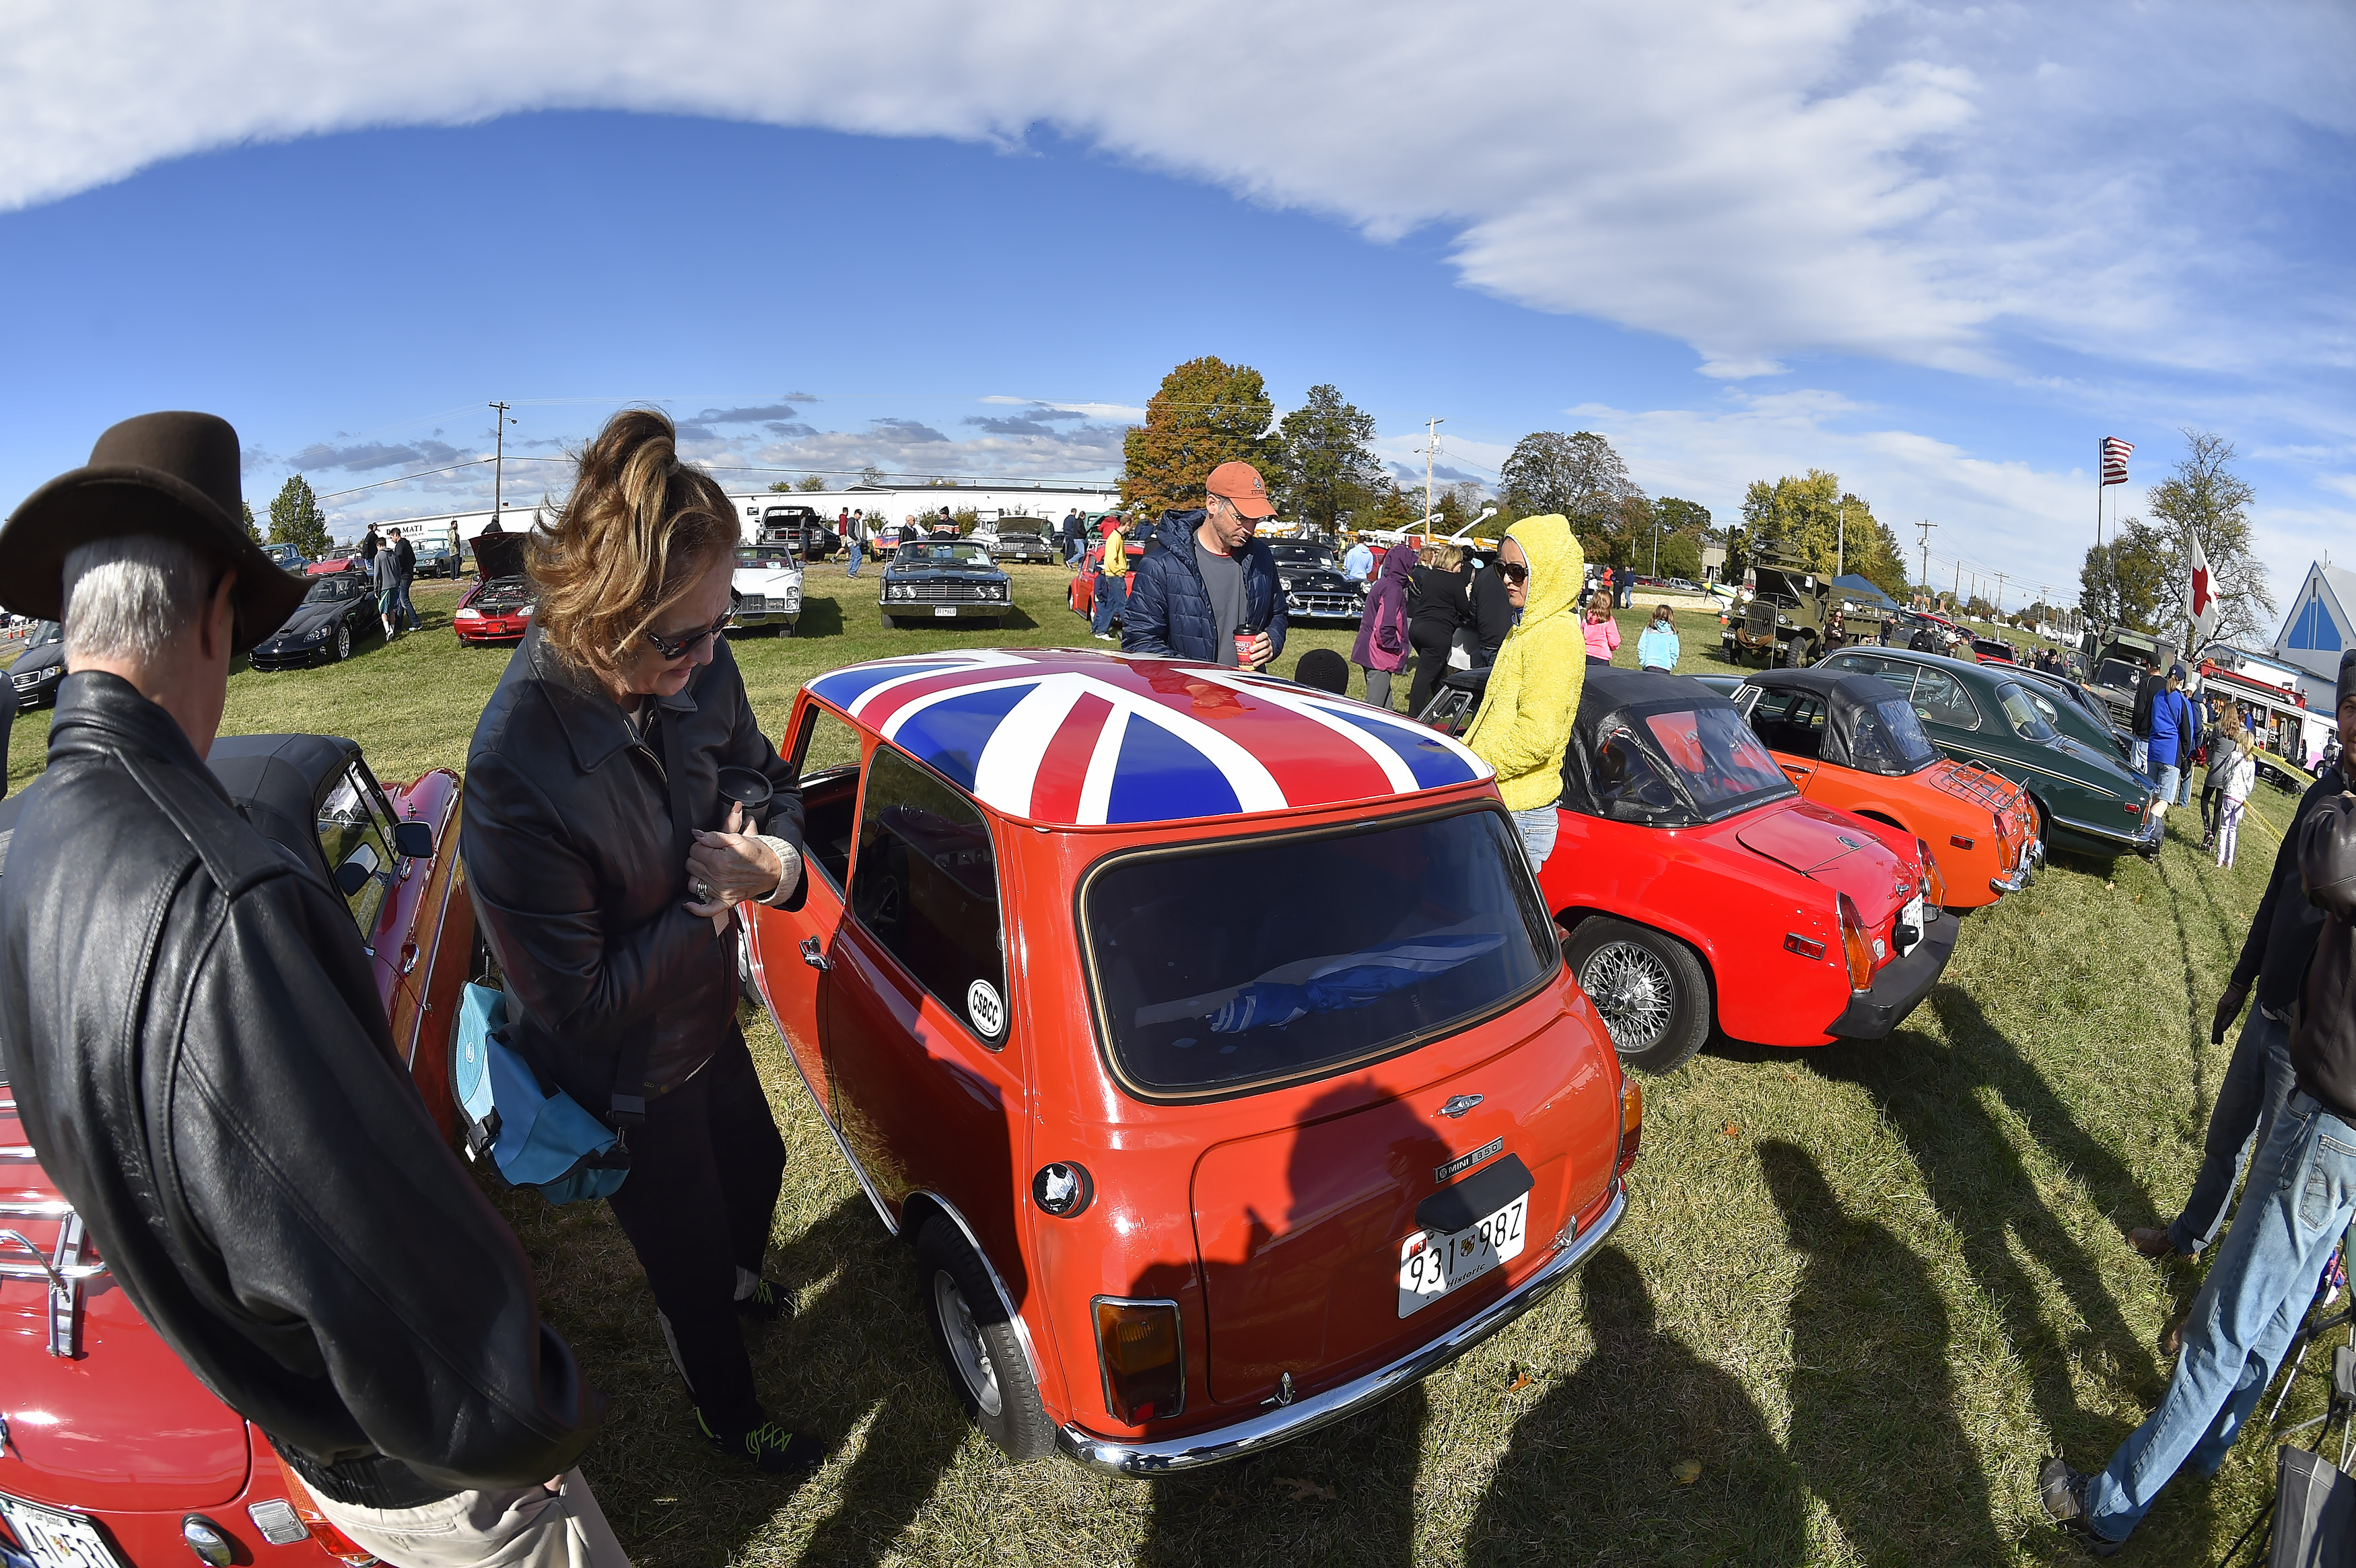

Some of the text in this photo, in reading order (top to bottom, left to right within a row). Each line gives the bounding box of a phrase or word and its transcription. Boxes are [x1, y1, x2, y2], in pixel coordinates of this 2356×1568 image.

[973, 989, 998, 1027] CSBCC
[1449, 1144, 1498, 1174] MINI 850
[1411, 1238, 1456, 1293] 931
[1445, 1262, 1486, 1290] Historic
